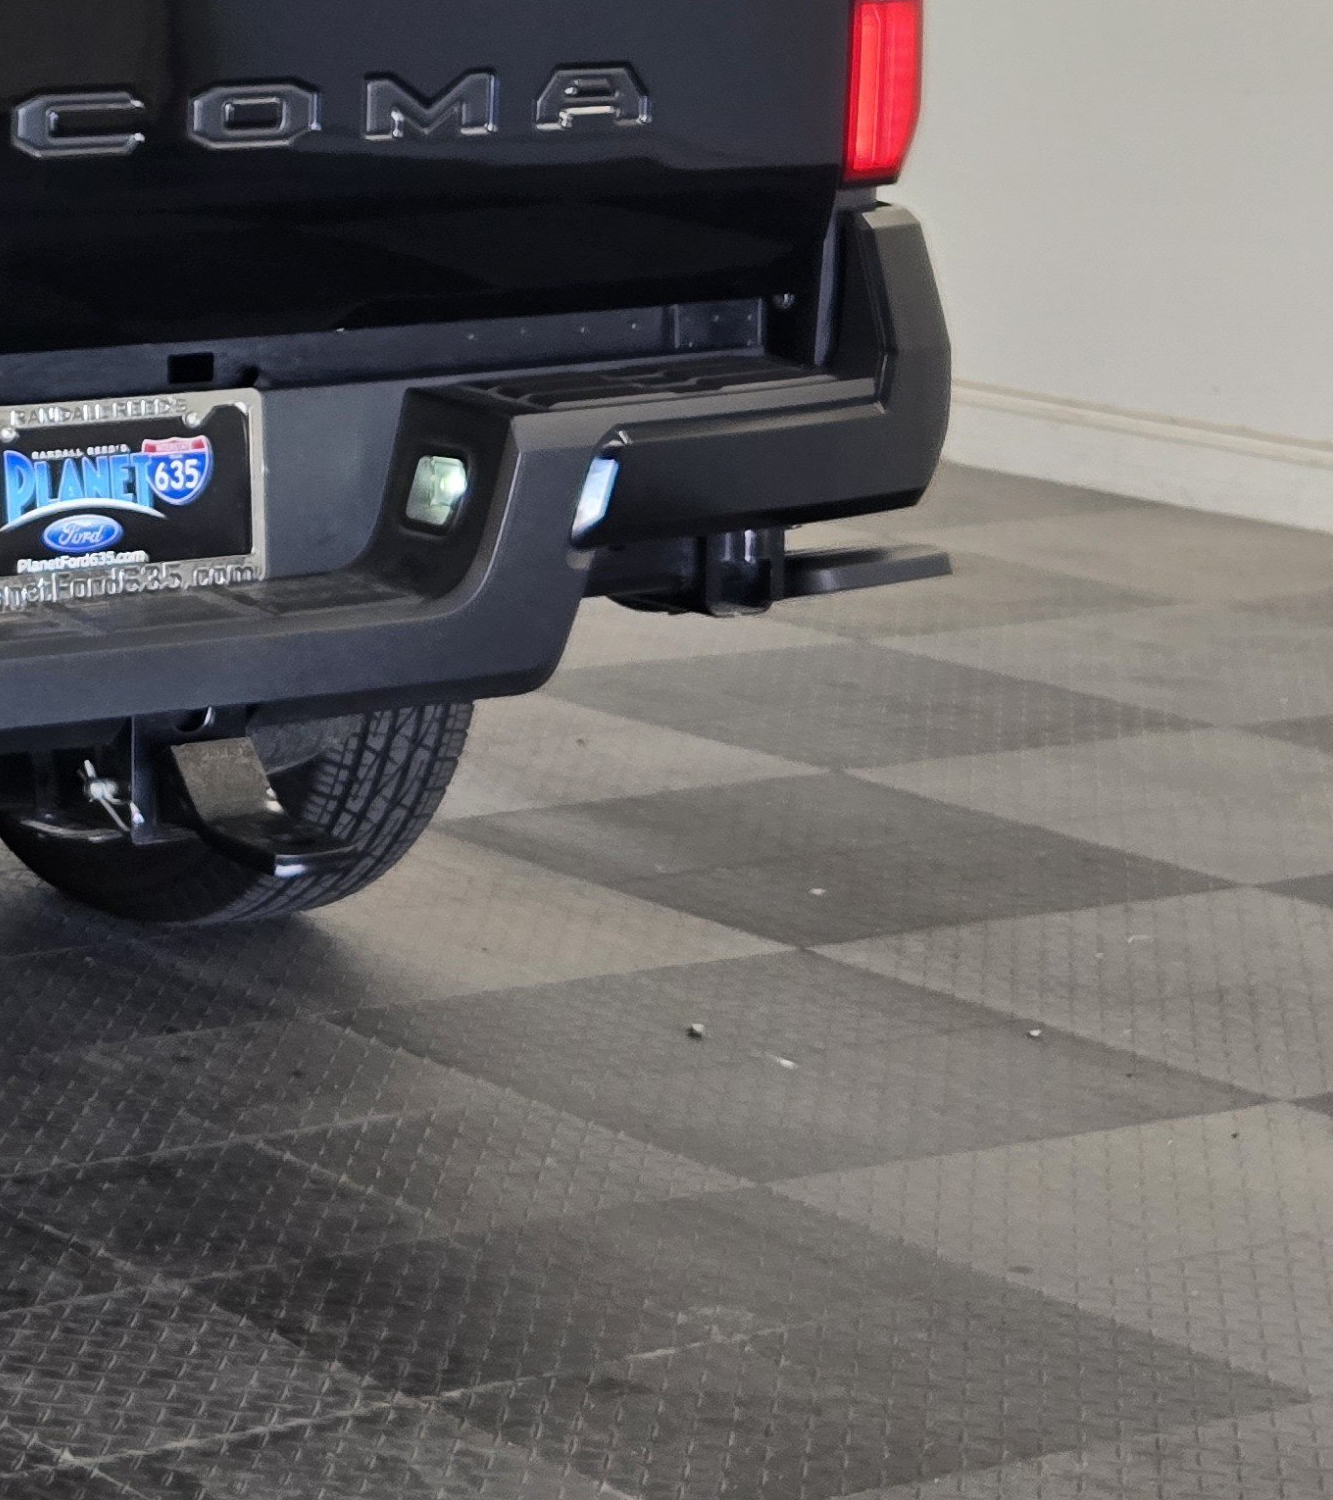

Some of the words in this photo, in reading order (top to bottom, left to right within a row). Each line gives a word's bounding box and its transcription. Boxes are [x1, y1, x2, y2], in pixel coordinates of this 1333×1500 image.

[10, 402, 110, 427] RANDALL
[154, 457, 200, 492] 635
[4, 450, 154, 525] PLANET
[58, 522, 104, 546] Ford
[16, 550, 150, 574] PlanetFord635.com
